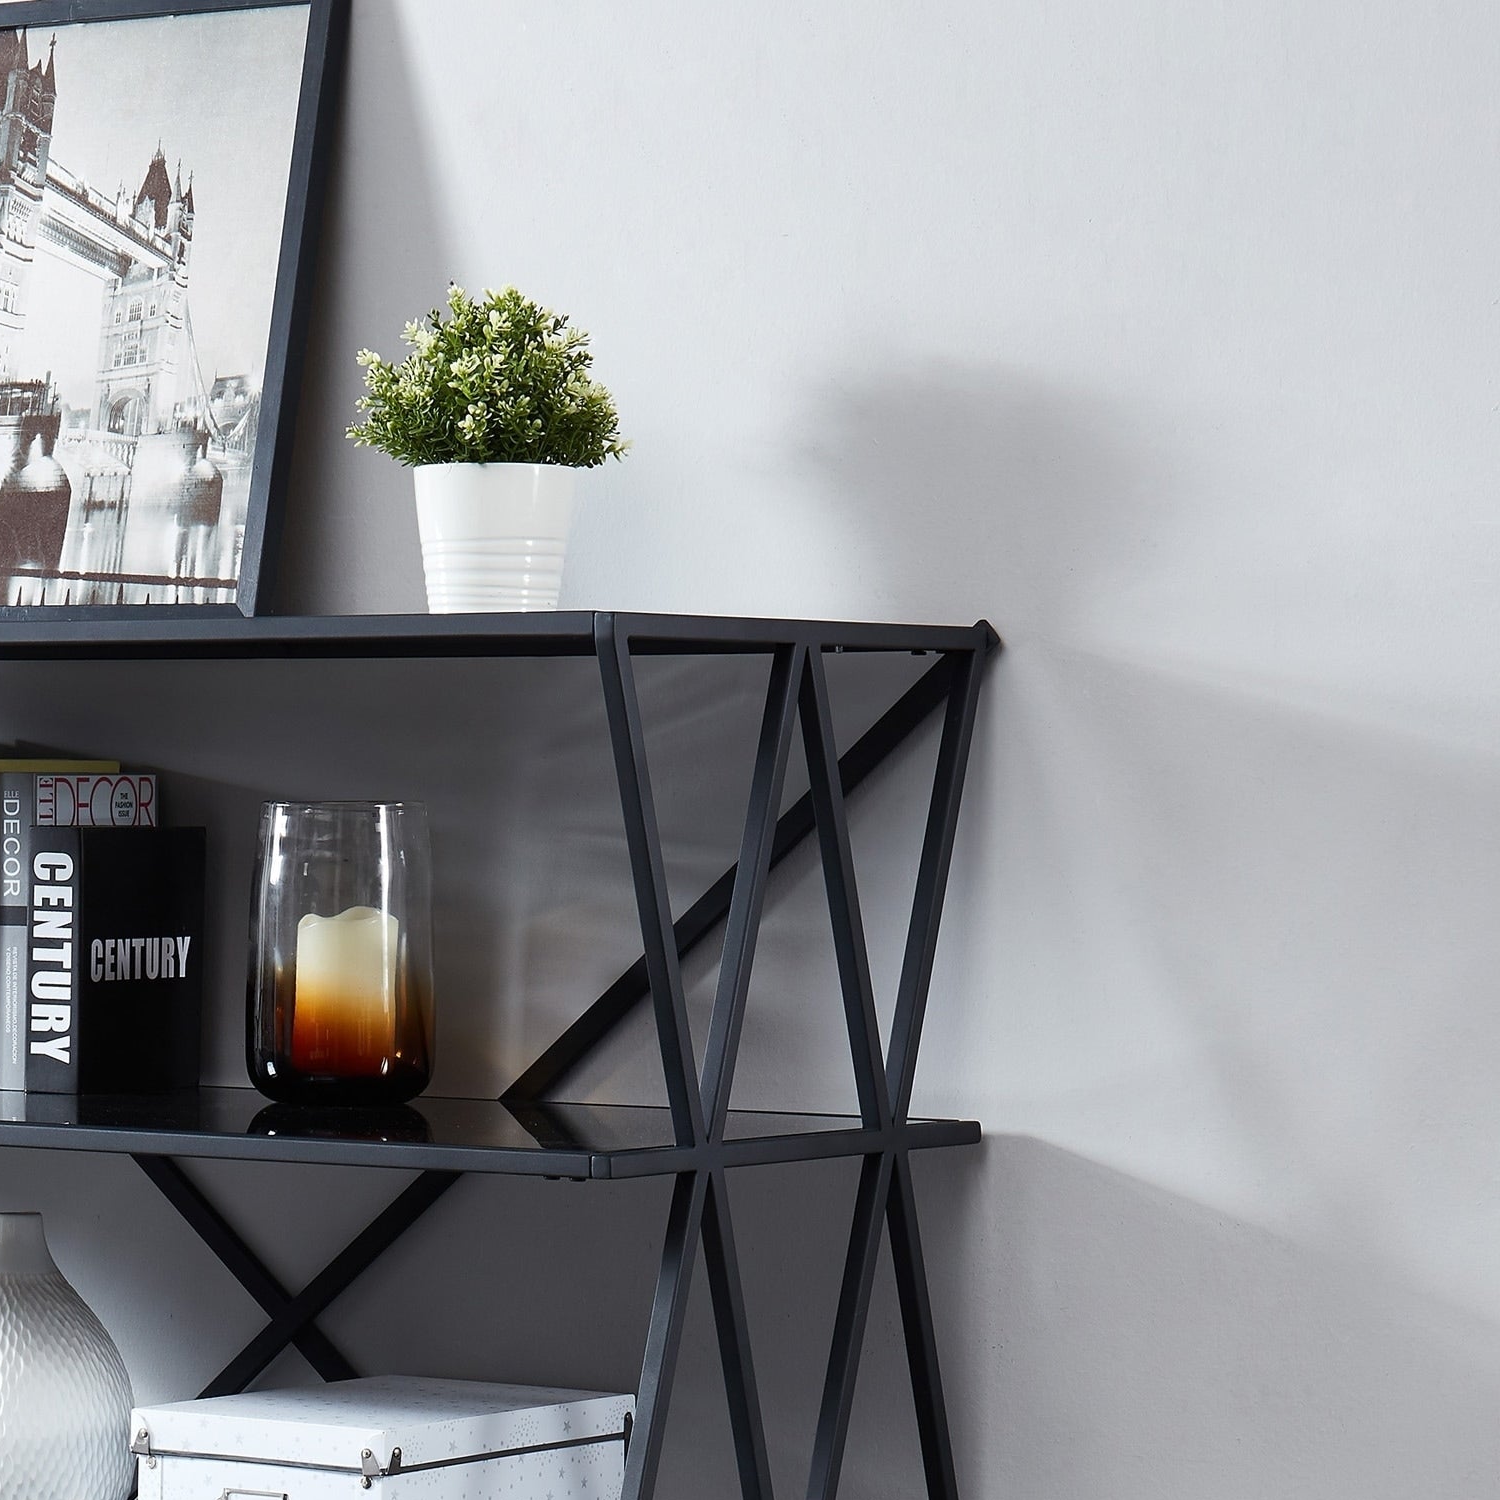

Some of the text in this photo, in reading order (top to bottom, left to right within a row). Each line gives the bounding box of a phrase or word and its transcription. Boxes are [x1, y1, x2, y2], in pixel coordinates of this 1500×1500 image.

[3, 790, 20, 798] ELLE
[39, 777, 53, 819] LLE
[54, 776, 156, 827] DECOR
[3, 799, 21, 897] DECOR
[30, 851, 74, 1065] CENTURY
[91, 936, 191, 983] CENTURY
